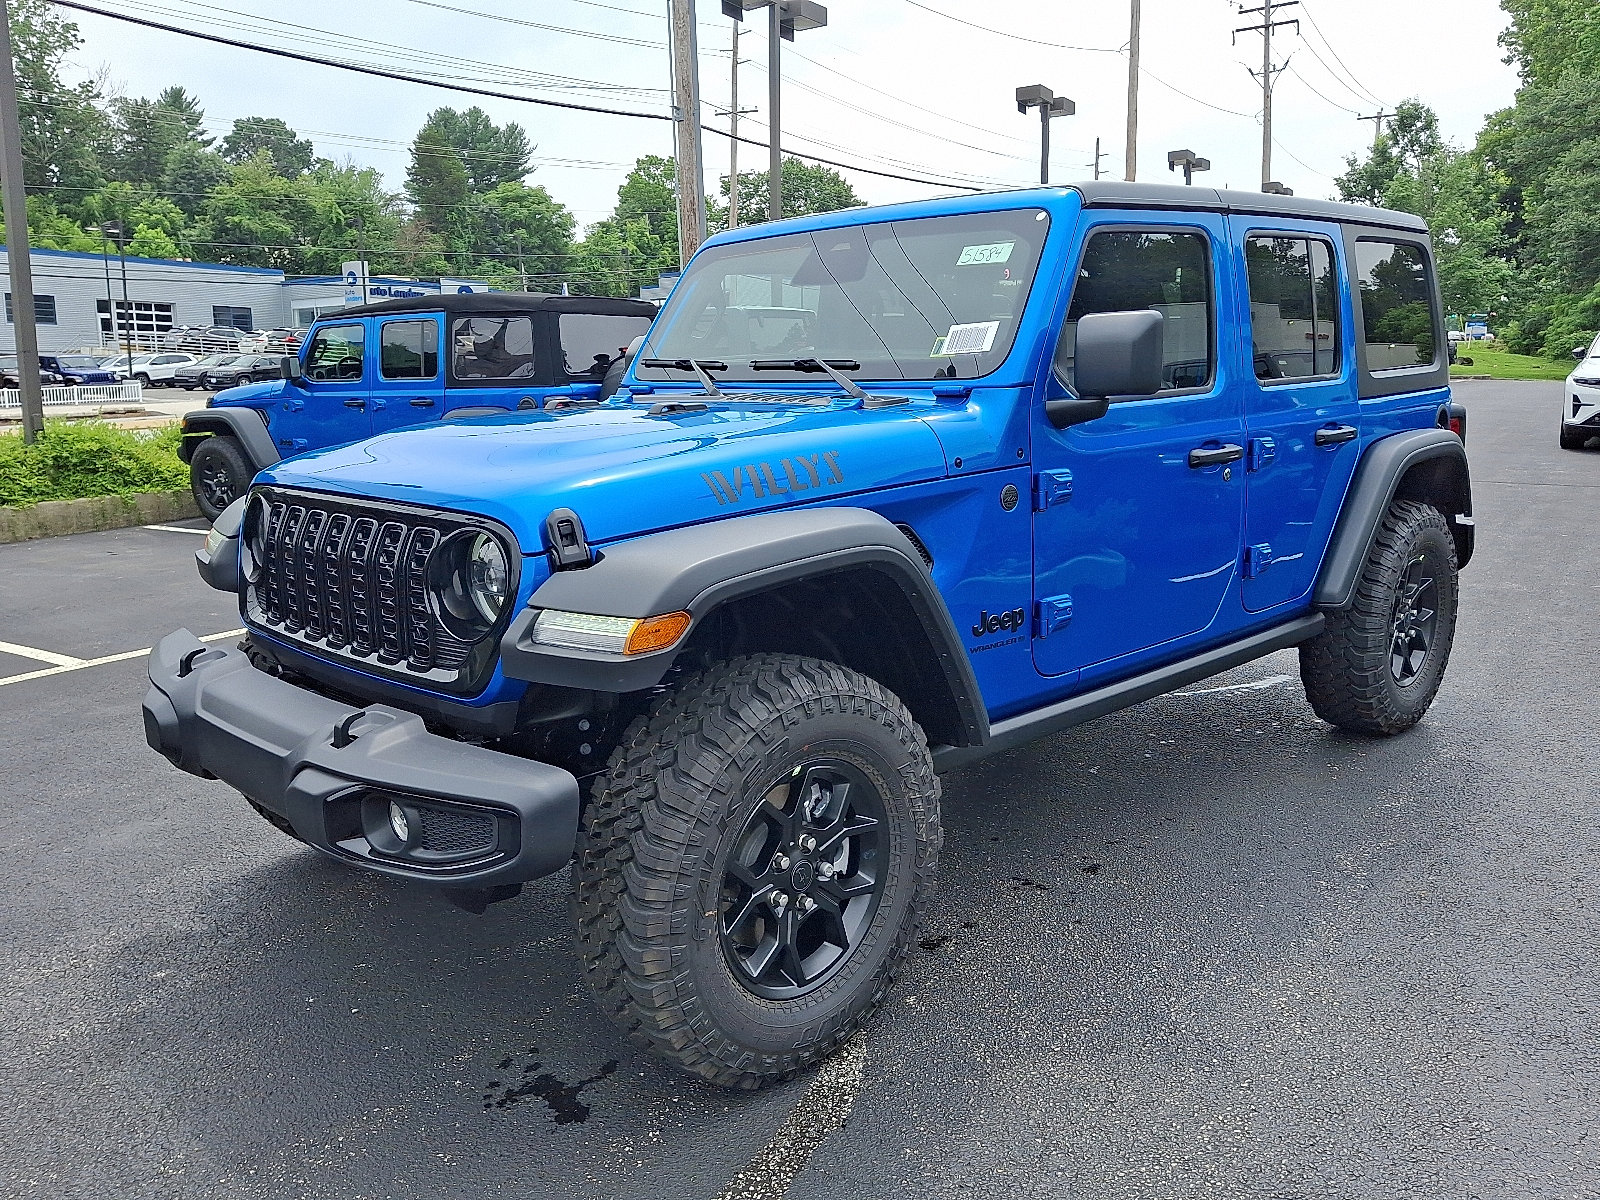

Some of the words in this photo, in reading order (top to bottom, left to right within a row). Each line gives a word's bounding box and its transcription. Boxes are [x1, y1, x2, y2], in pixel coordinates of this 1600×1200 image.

[370, 287, 388, 296] uto
[700, 450, 844, 506] WILLYS
[972, 606, 1024, 637] Jeep
[969, 637, 1017, 654] WRANGLER
